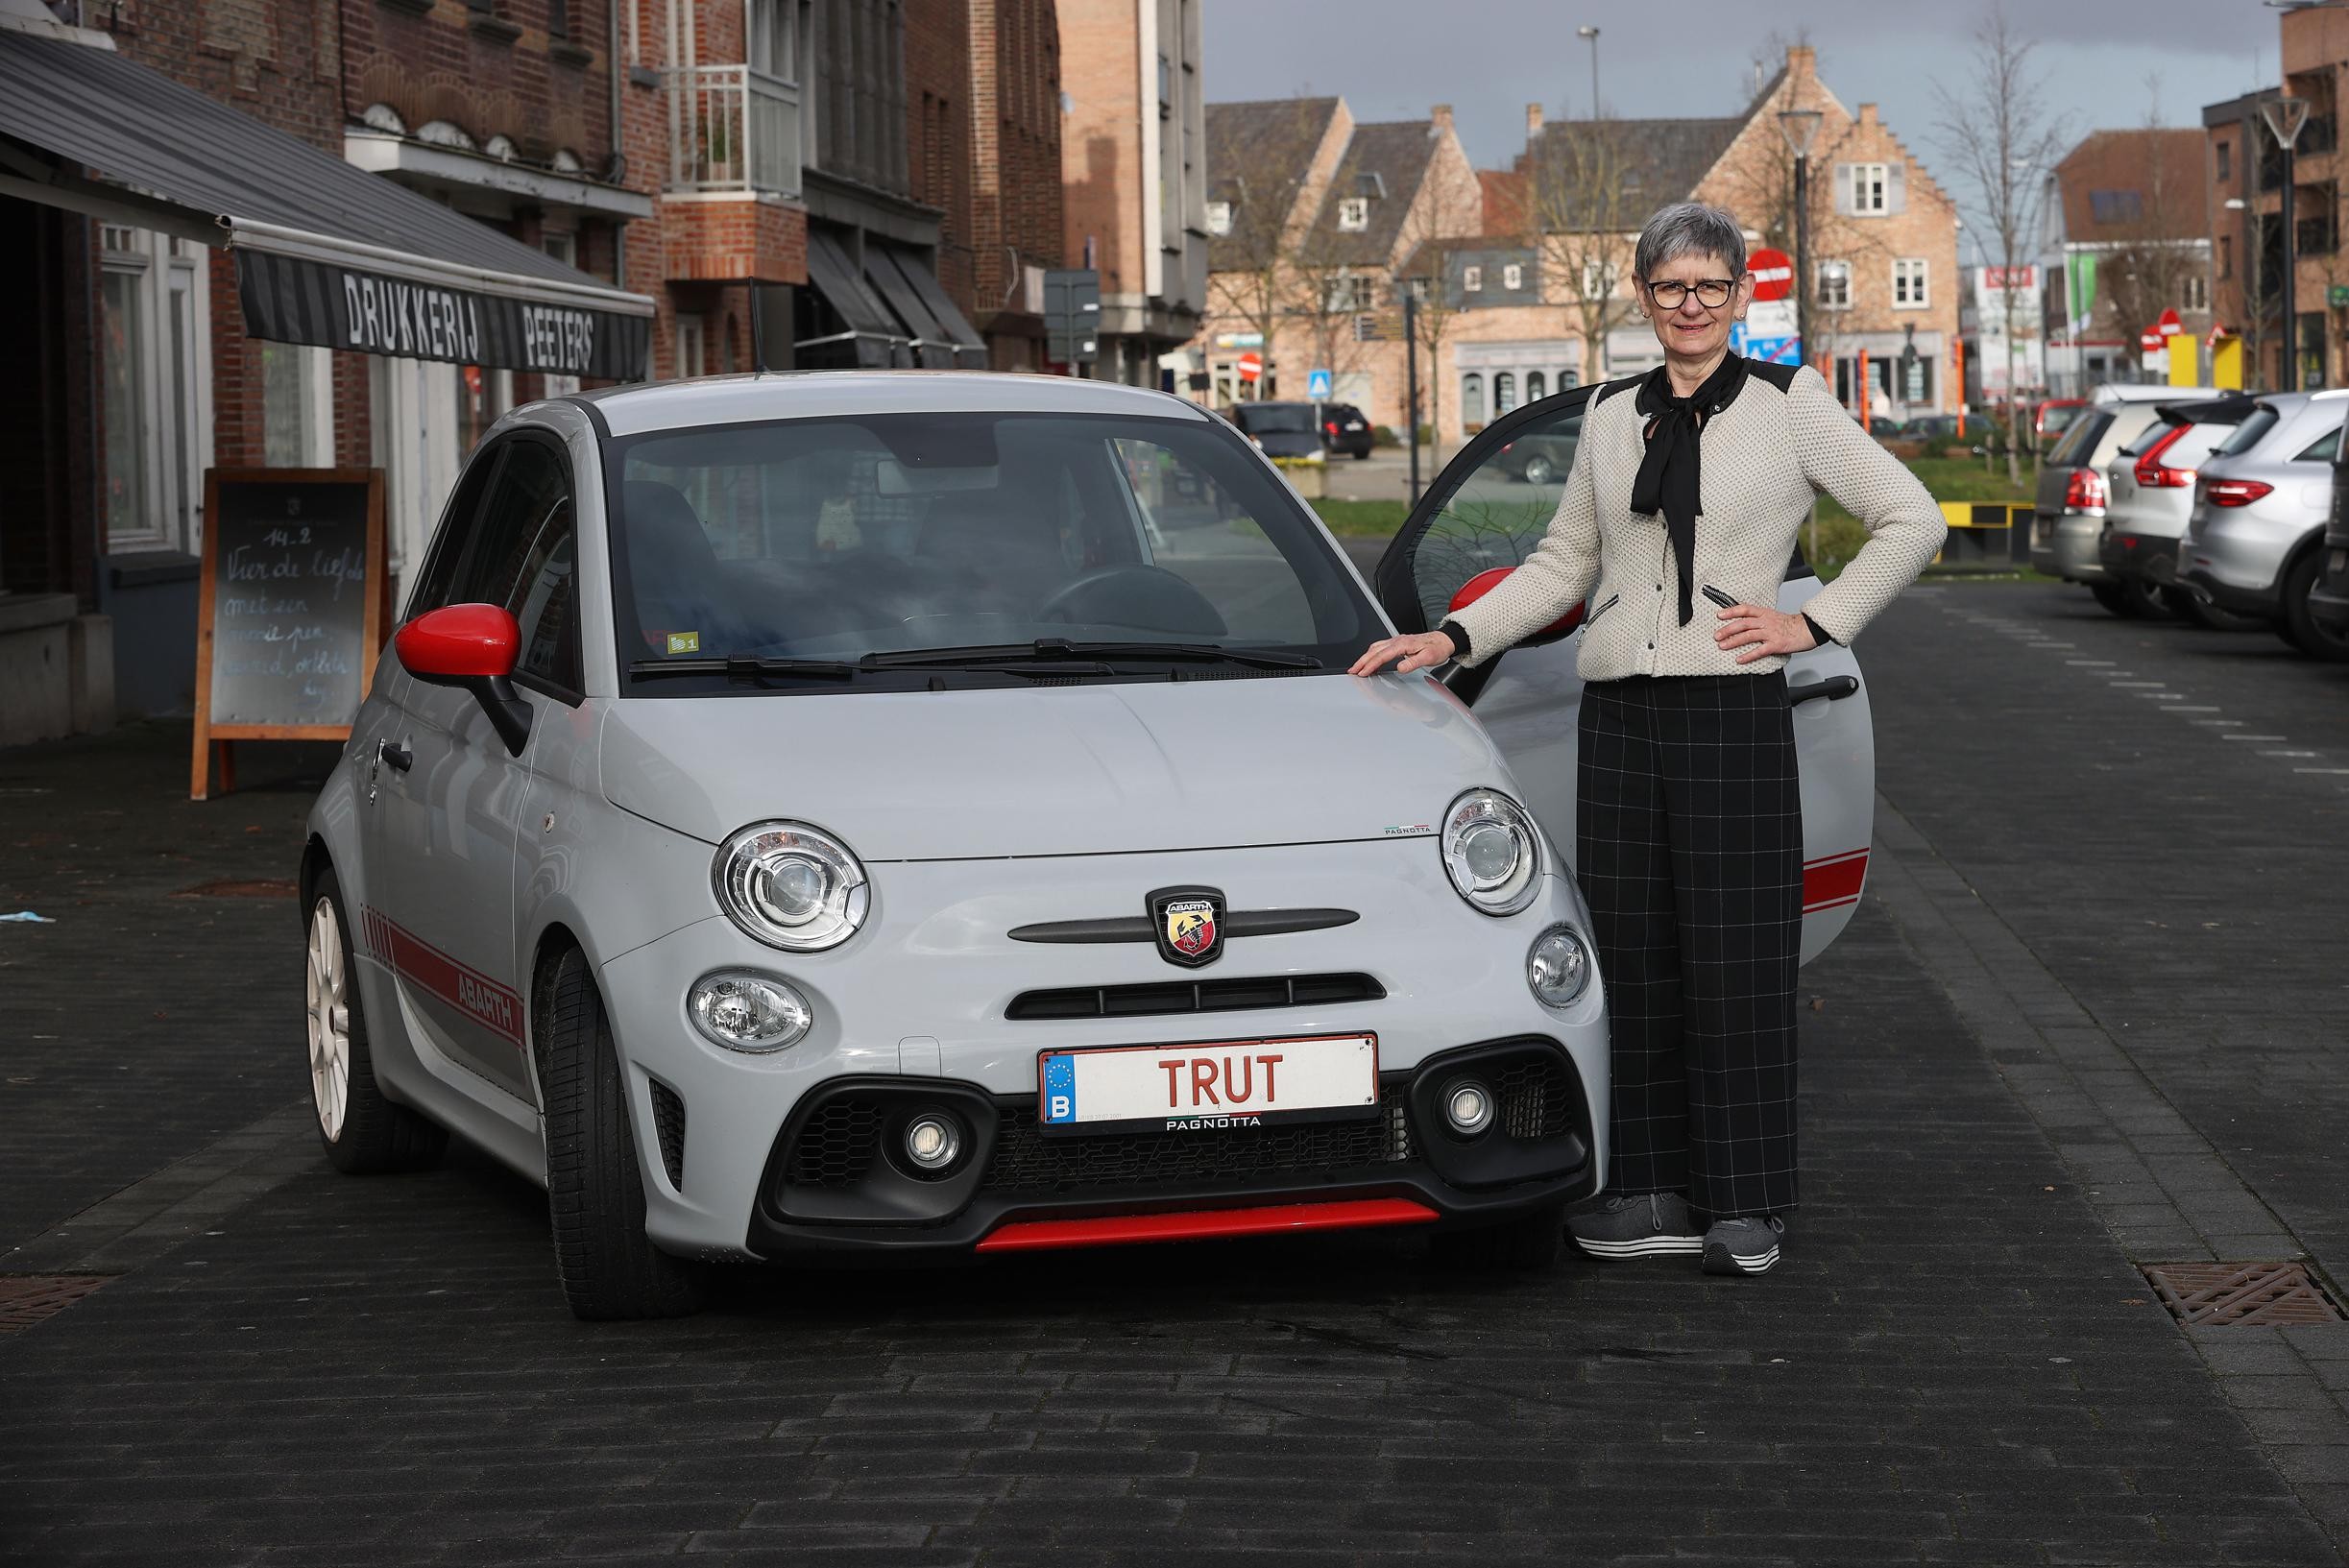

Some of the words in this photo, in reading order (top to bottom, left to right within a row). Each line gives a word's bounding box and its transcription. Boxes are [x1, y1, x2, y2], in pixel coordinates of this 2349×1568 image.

[343, 275, 479, 360] DRUKKERIJ
[522, 305, 594, 371] PEETERS
[458, 974, 513, 1030] ABARTH
[1158, 1054, 1283, 1107] TRUT
[1052, 1096, 1070, 1119] B
[1166, 1117, 1261, 1131] PAGNOTTA
